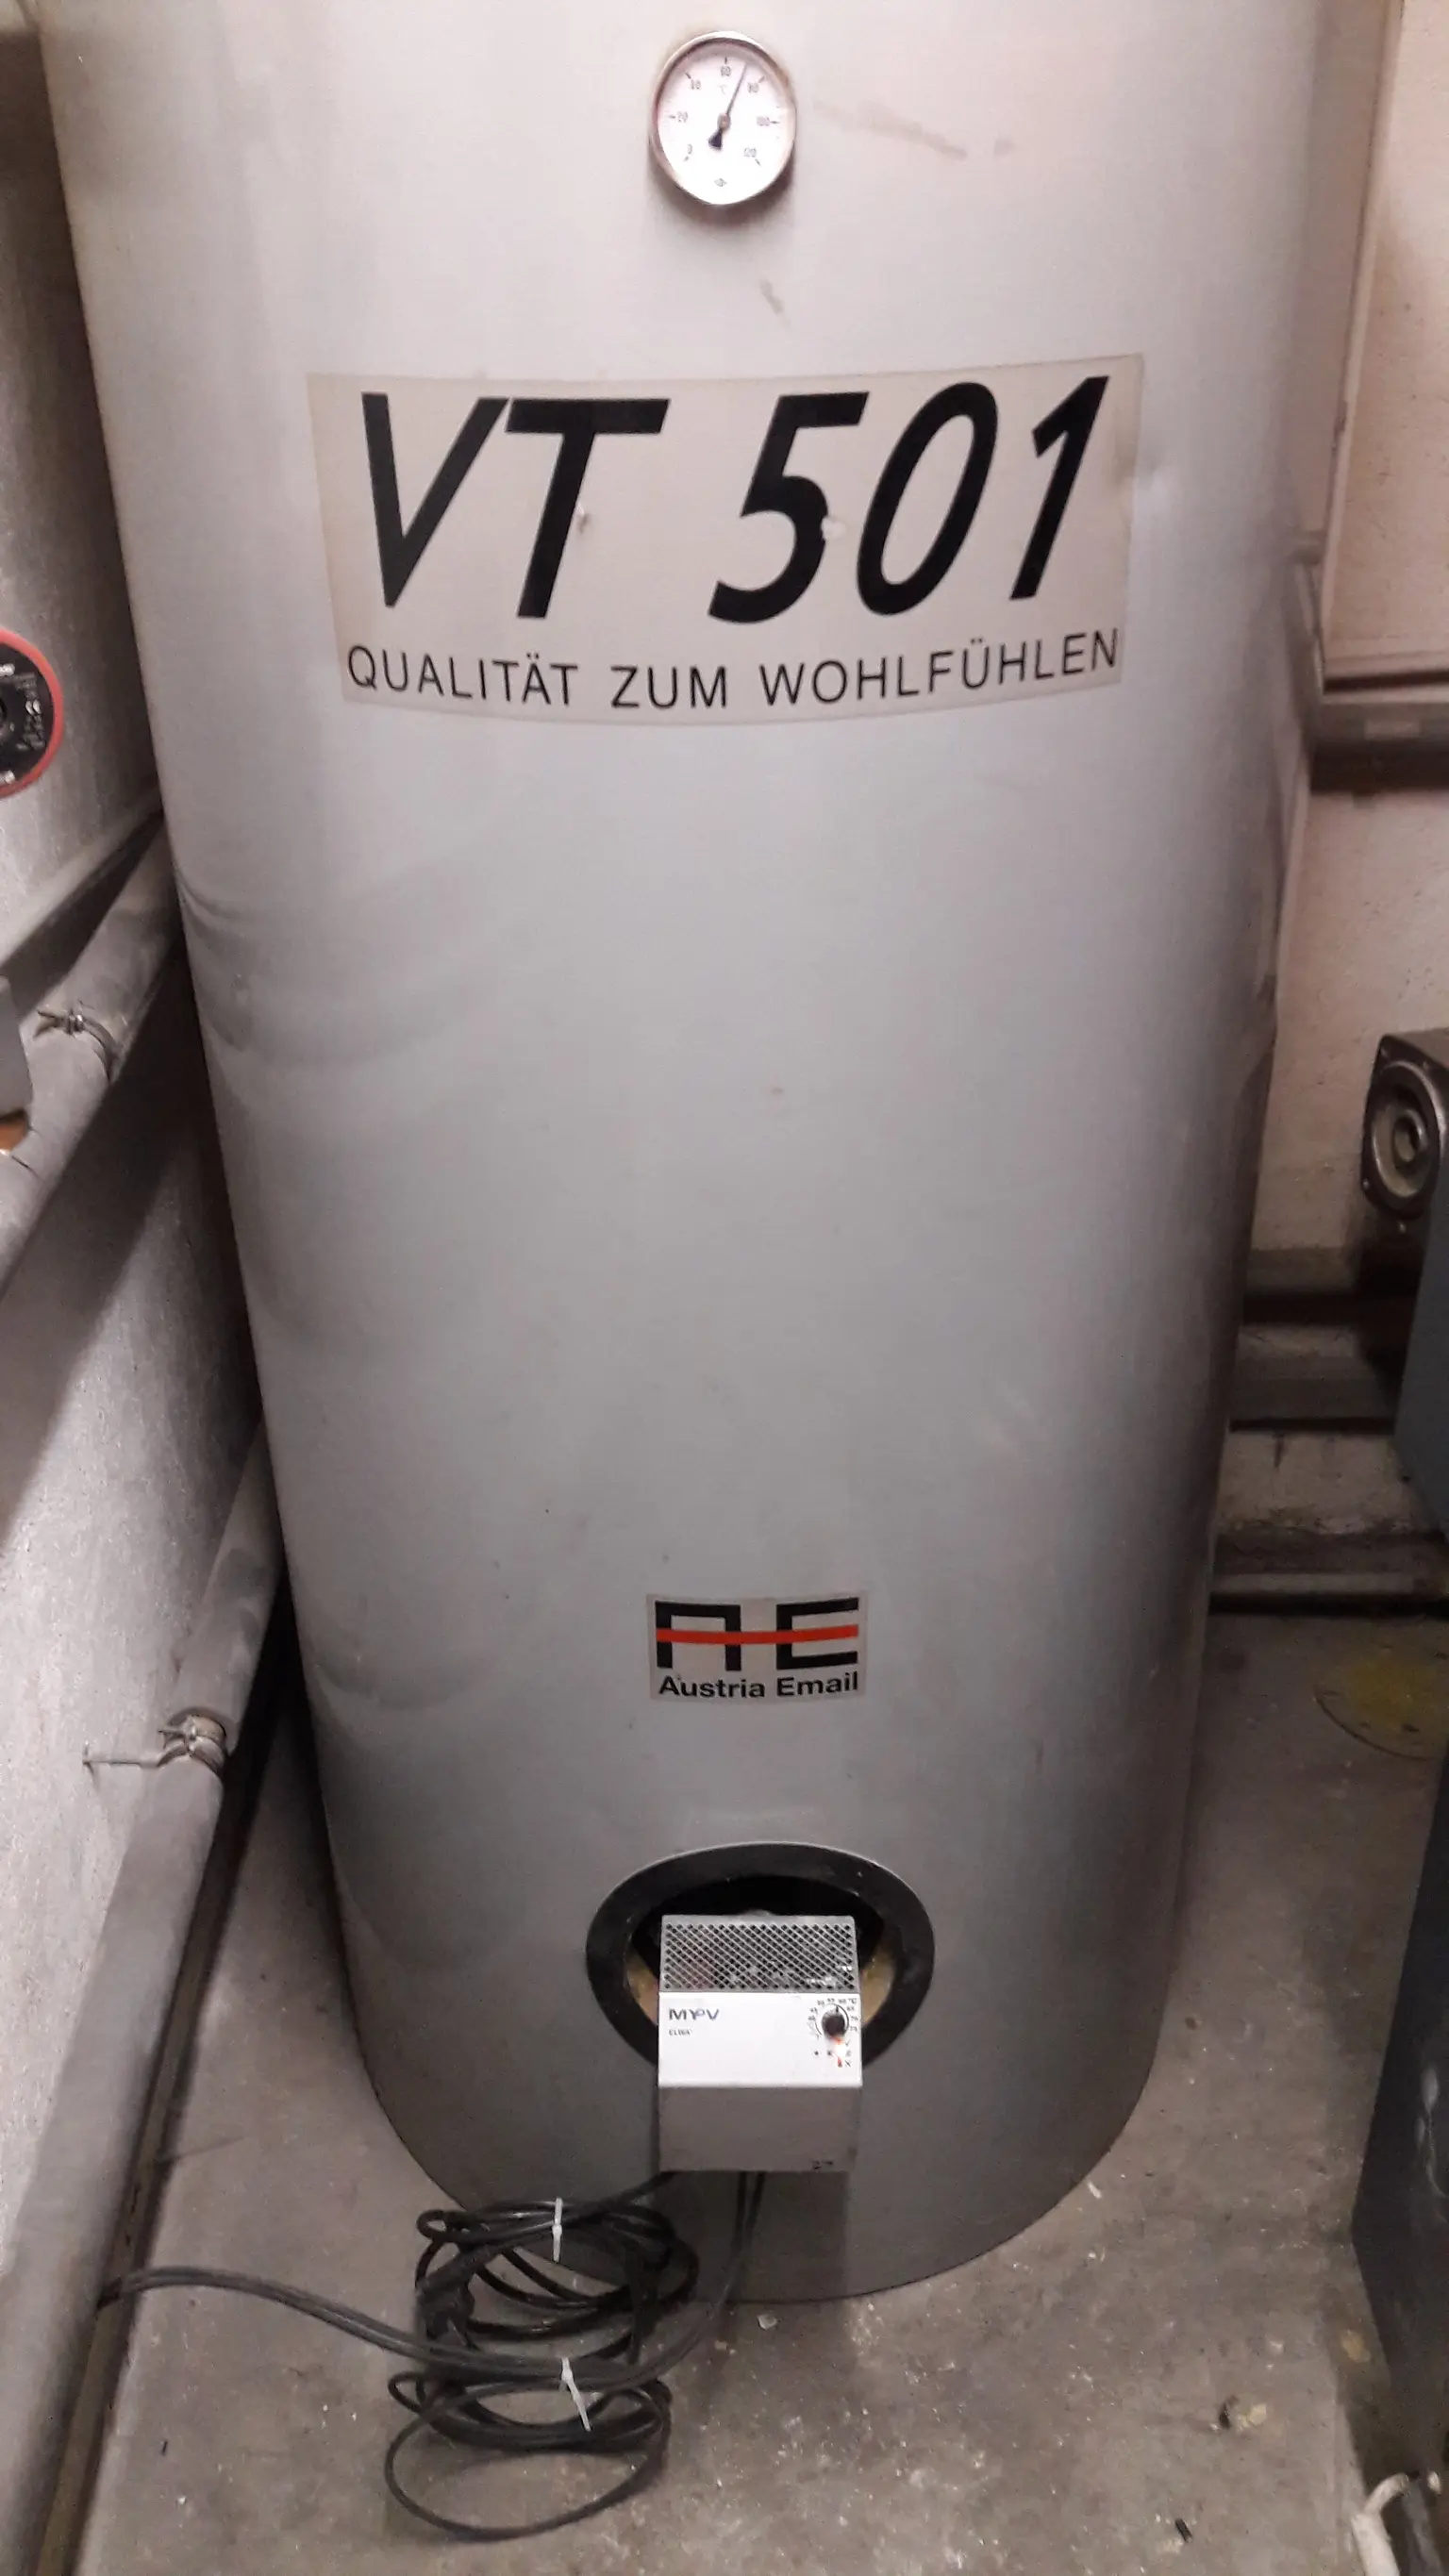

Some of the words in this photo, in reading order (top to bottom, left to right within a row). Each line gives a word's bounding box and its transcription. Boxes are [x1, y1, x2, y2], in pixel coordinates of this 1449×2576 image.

[362, 393, 670, 620] VT
[709, 375, 1109, 624] 501
[347, 643, 578, 706] QUALITÄT
[609, 666, 726, 709] ZUM
[760, 627, 1118, 706] WOHLFÜHLEN
[658, 1675, 765, 1698] Austria
[776, 1670, 858, 1697] Email
